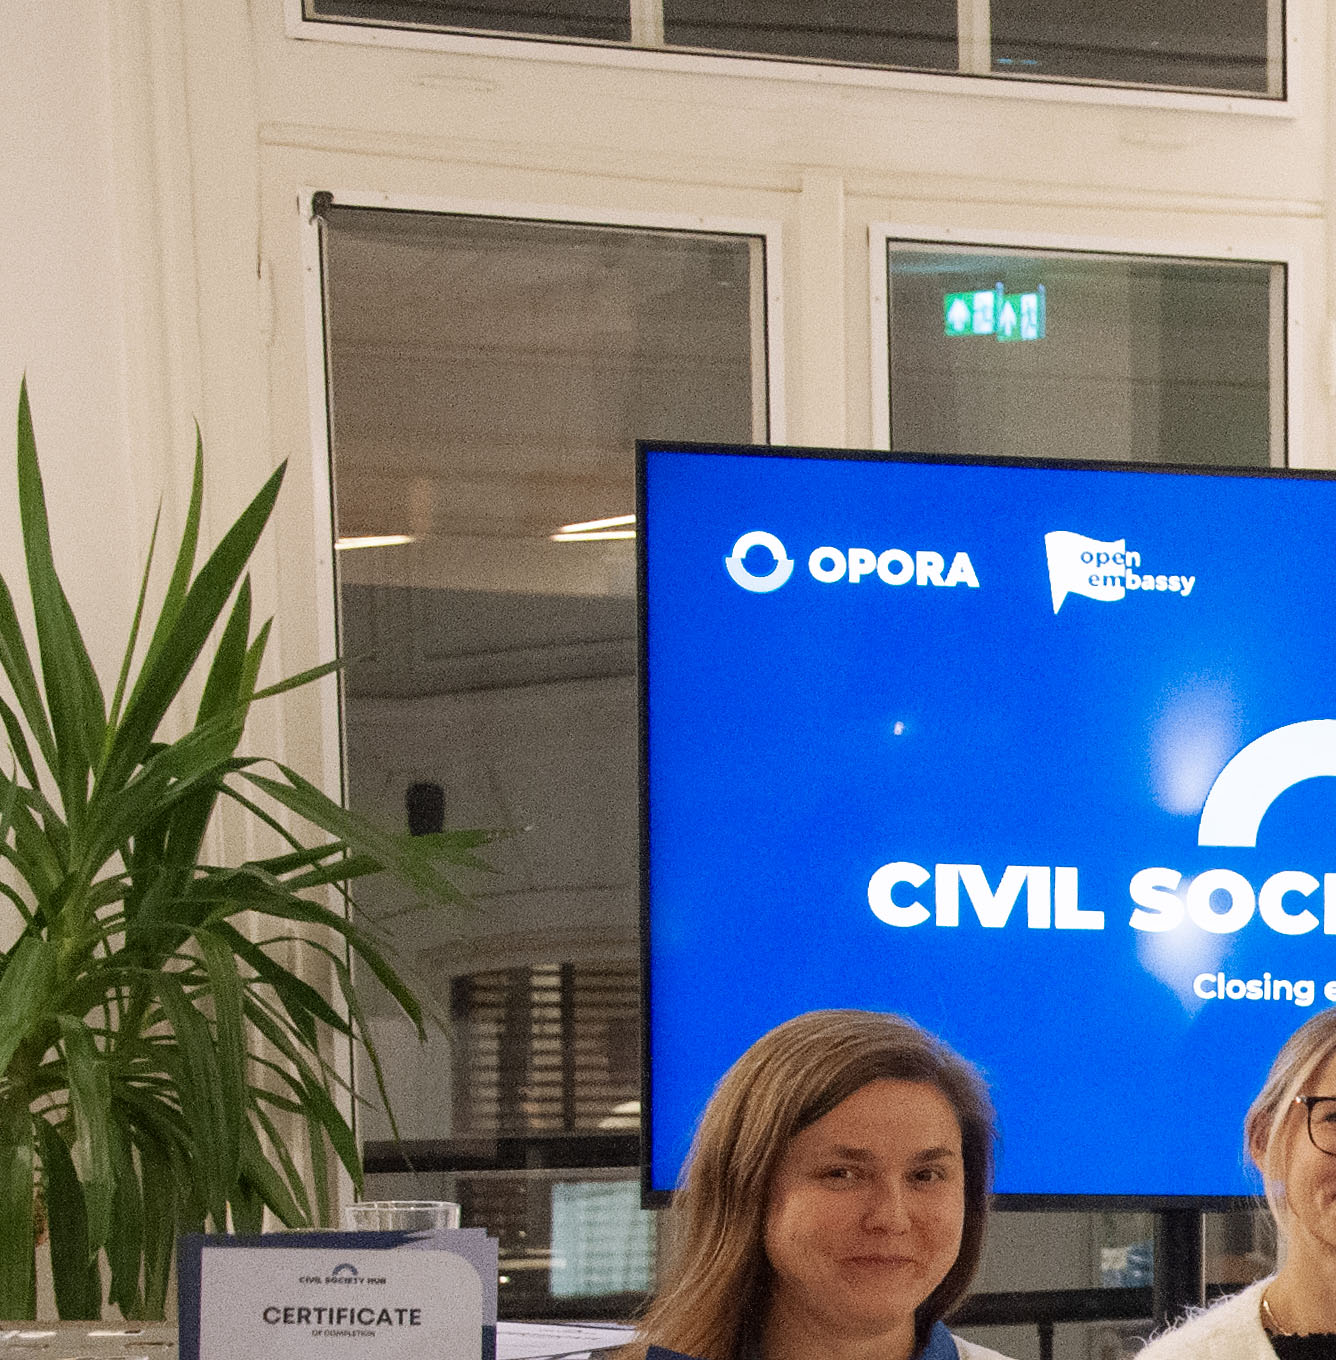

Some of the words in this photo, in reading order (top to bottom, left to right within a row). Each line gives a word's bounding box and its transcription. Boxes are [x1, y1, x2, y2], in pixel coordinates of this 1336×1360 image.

[808, 546, 980, 588] OPORA
[1080, 548, 1140, 567] open
[1088, 566, 1195, 597] embassy
[867, 861, 1104, 930] CIVIL
[1193, 972, 1315, 1007] Closing
[262, 1307, 421, 1325] CERTIFICATE
